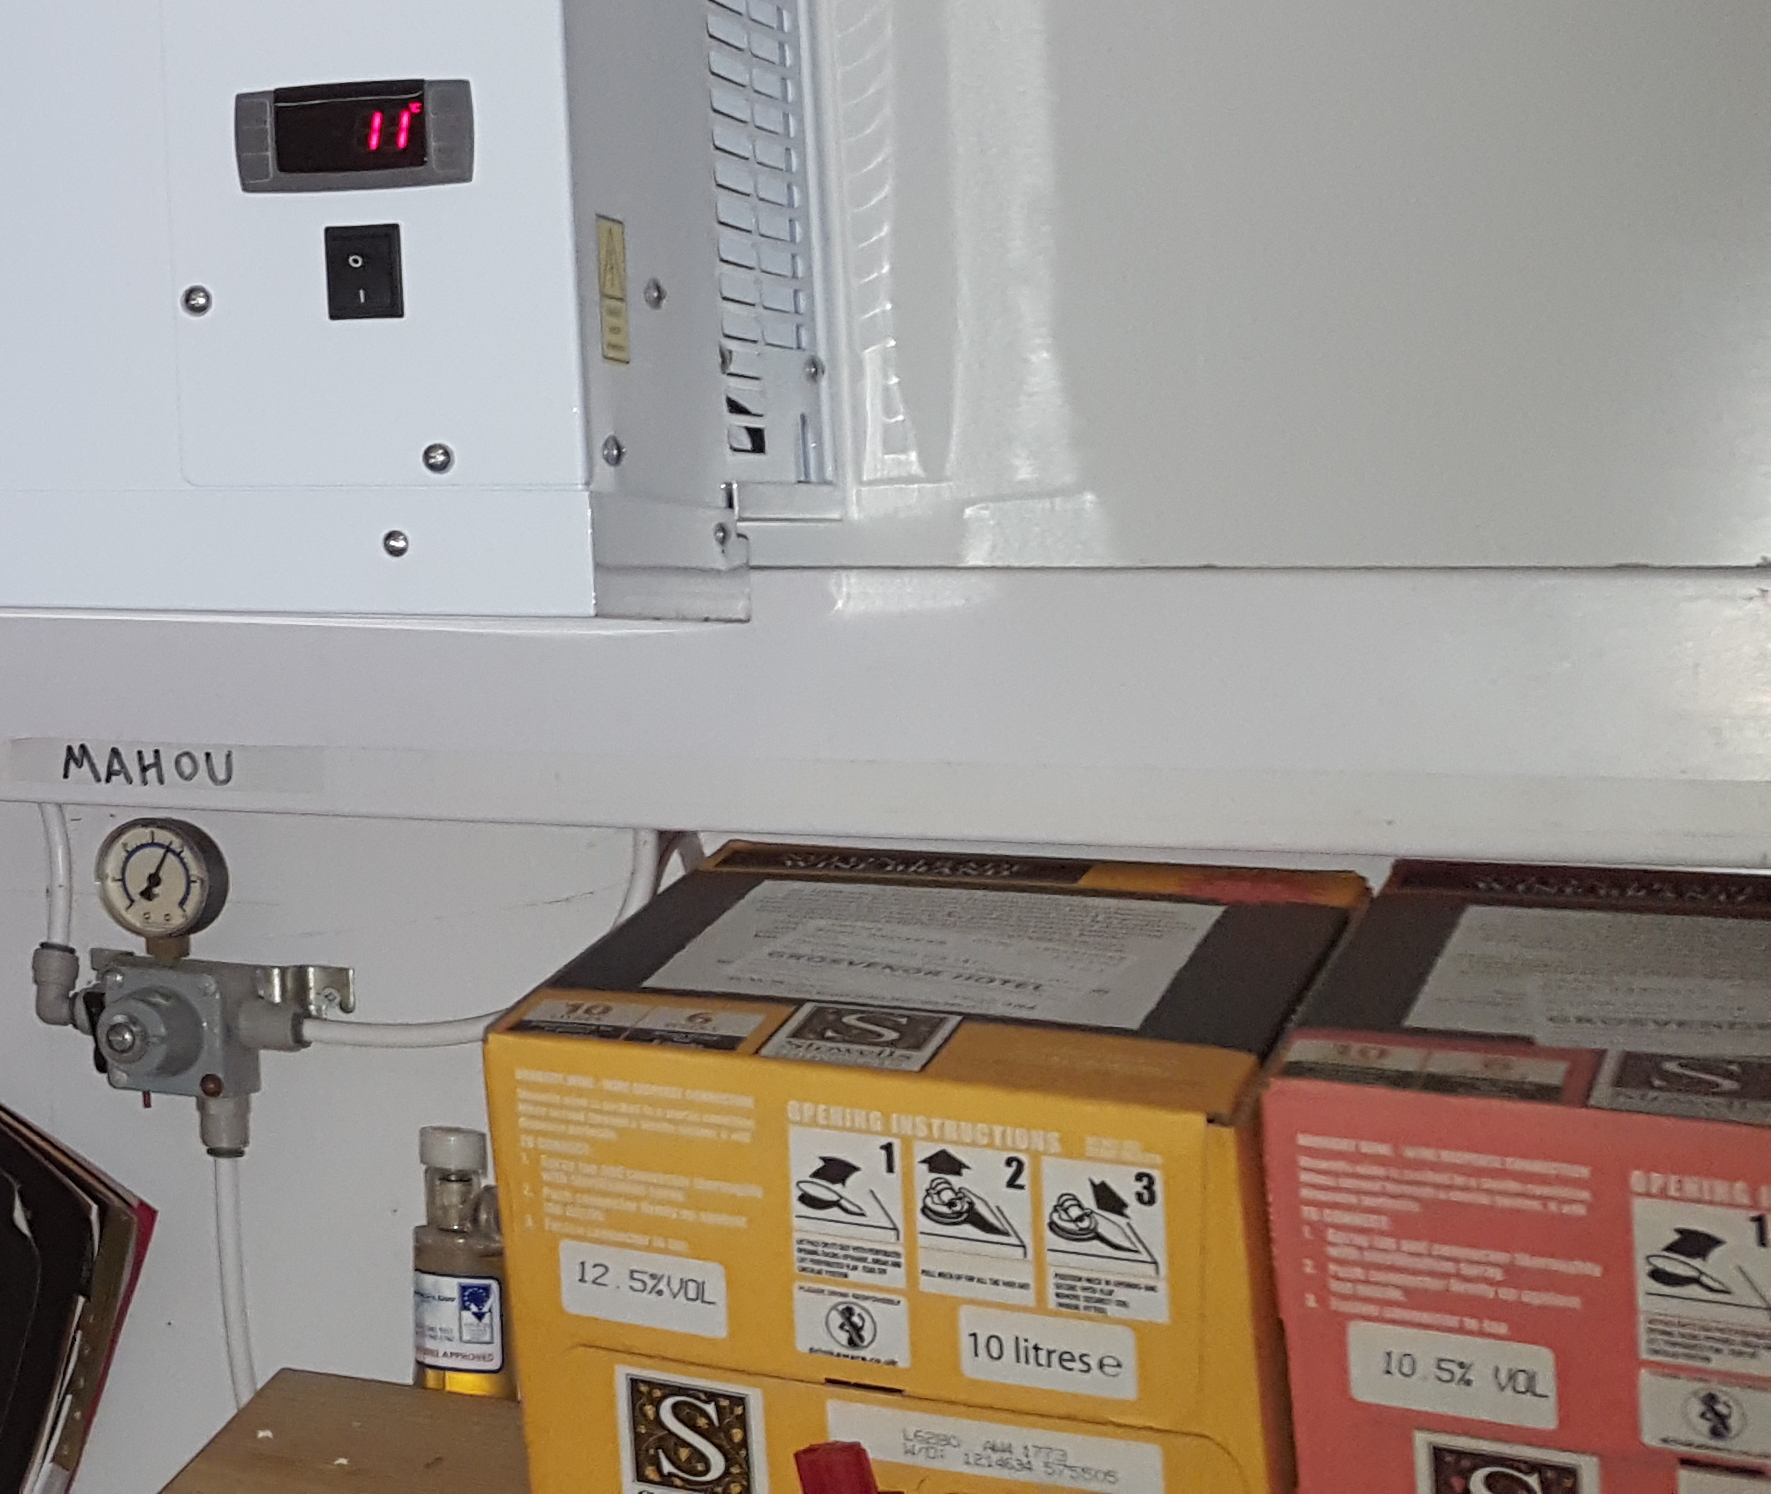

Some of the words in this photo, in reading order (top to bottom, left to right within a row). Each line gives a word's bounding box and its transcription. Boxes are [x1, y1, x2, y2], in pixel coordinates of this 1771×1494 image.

[62, 742, 234, 787] MAHOU
[787, 1100, 884, 1133] OPENING
[890, 1112, 1061, 1155] INSTRUCTIONS
[878, 1141, 896, 1175] 1
[1003, 1155, 1026, 1191] 2
[1133, 1170, 1157, 1207] 3
[968, 1331, 1004, 1361] 10
[1013, 1335, 1092, 1375] litres
[1493, 1364, 1550, 1400] VOL
